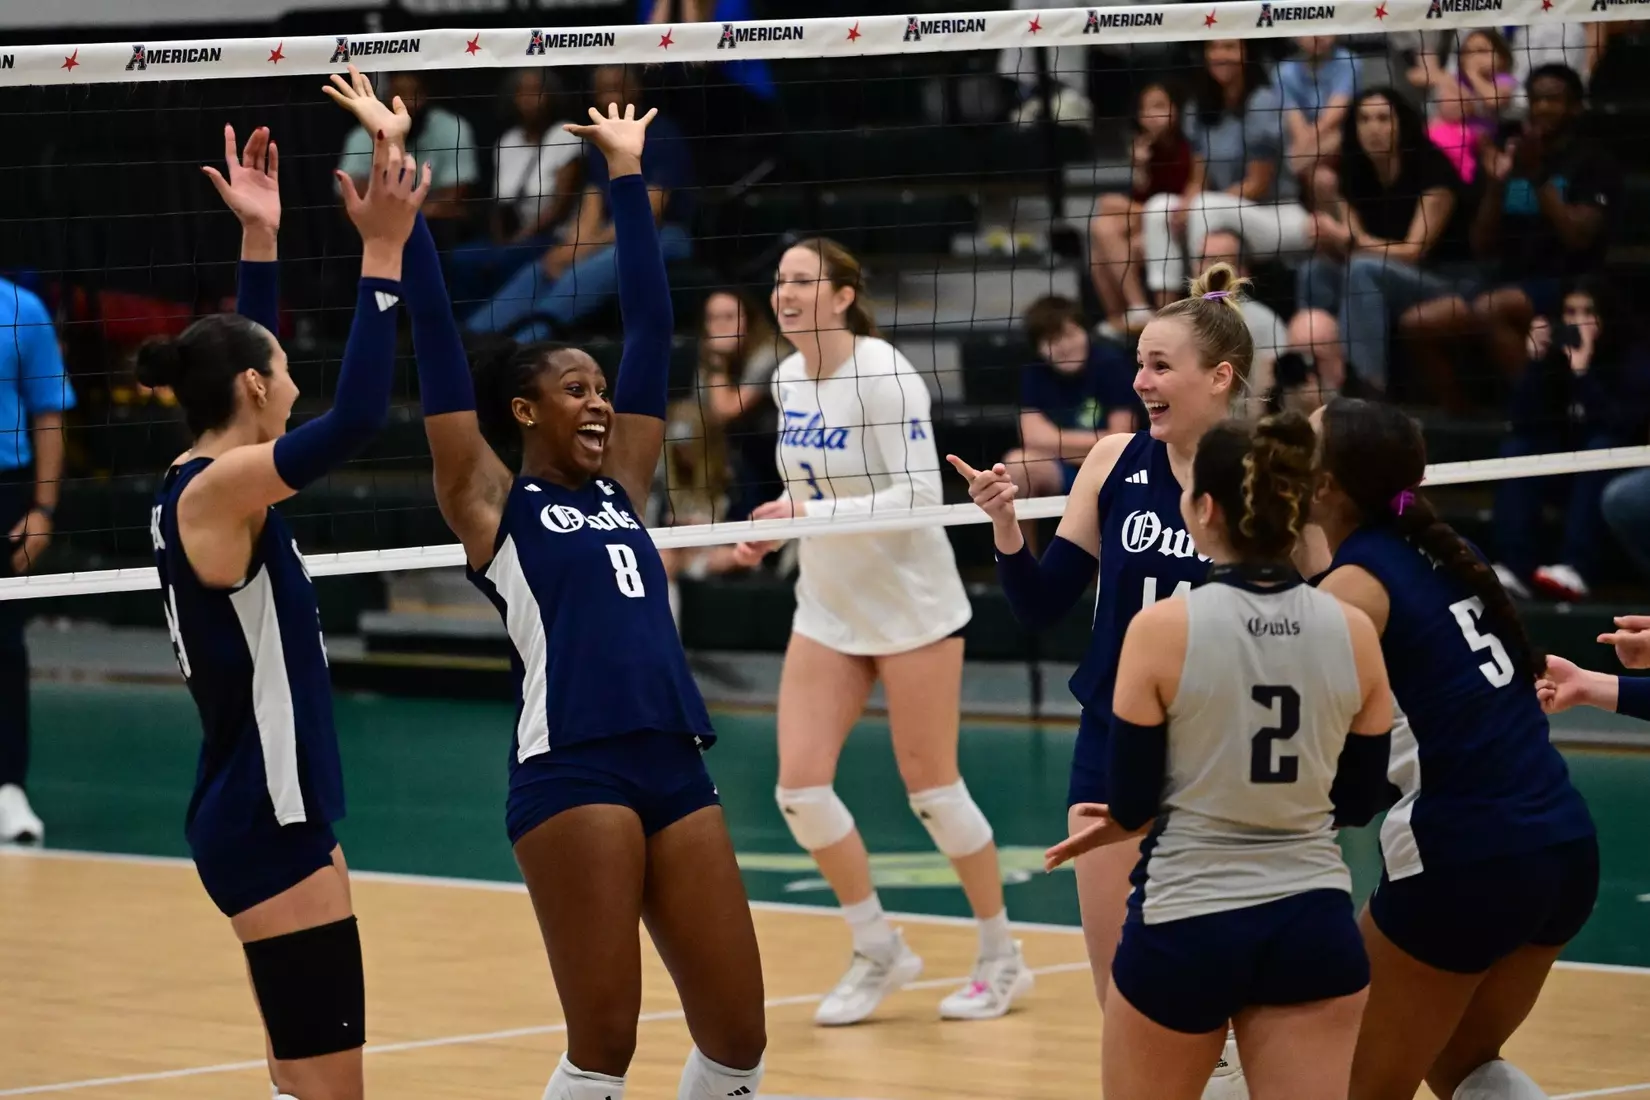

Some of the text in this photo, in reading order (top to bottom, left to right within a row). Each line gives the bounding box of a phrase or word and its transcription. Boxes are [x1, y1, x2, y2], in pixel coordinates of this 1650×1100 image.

[903, 16, 986, 42] AMERICAN
[1082, 10, 1164, 35] AMERICAN
[1256, 4, 1335, 27] AMERICAN
[330, 36, 421, 63] AMERICAN
[526, 29, 615, 55] AMERICAN
[717, 23, 804, 49] AMERICAN
[126, 44, 221, 71] AMERICAN
[784, 410, 849, 450] Tulsa
[540, 501, 641, 534] Owls
[1121, 510, 1215, 563] Ow
[605, 544, 646, 598] 8
[1247, 617, 1301, 638] Owls
[1448, 595, 1515, 689] 5
[1250, 685, 1301, 784] 2
